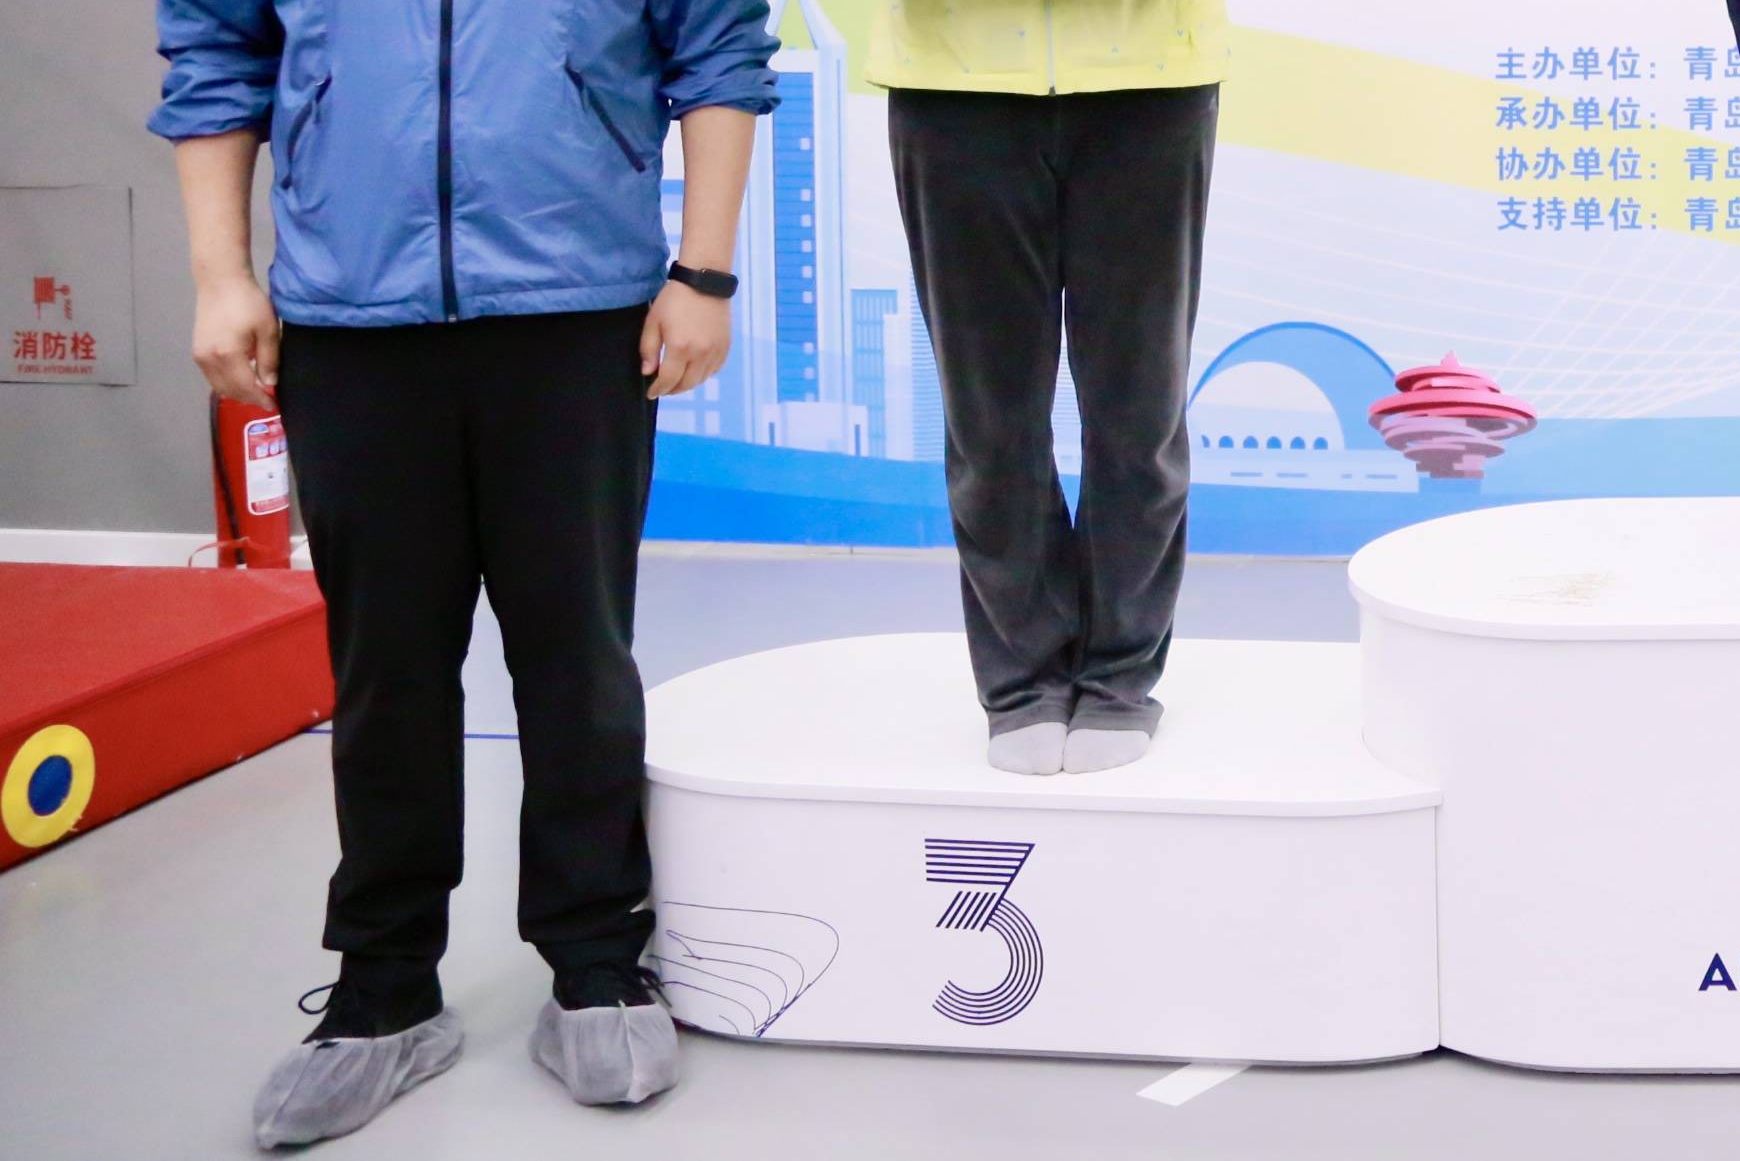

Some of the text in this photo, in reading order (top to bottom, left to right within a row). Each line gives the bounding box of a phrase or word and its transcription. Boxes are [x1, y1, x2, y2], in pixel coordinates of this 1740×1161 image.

[13, 331, 97, 360] 消防栓
[924, 837, 1043, 1026] 3
